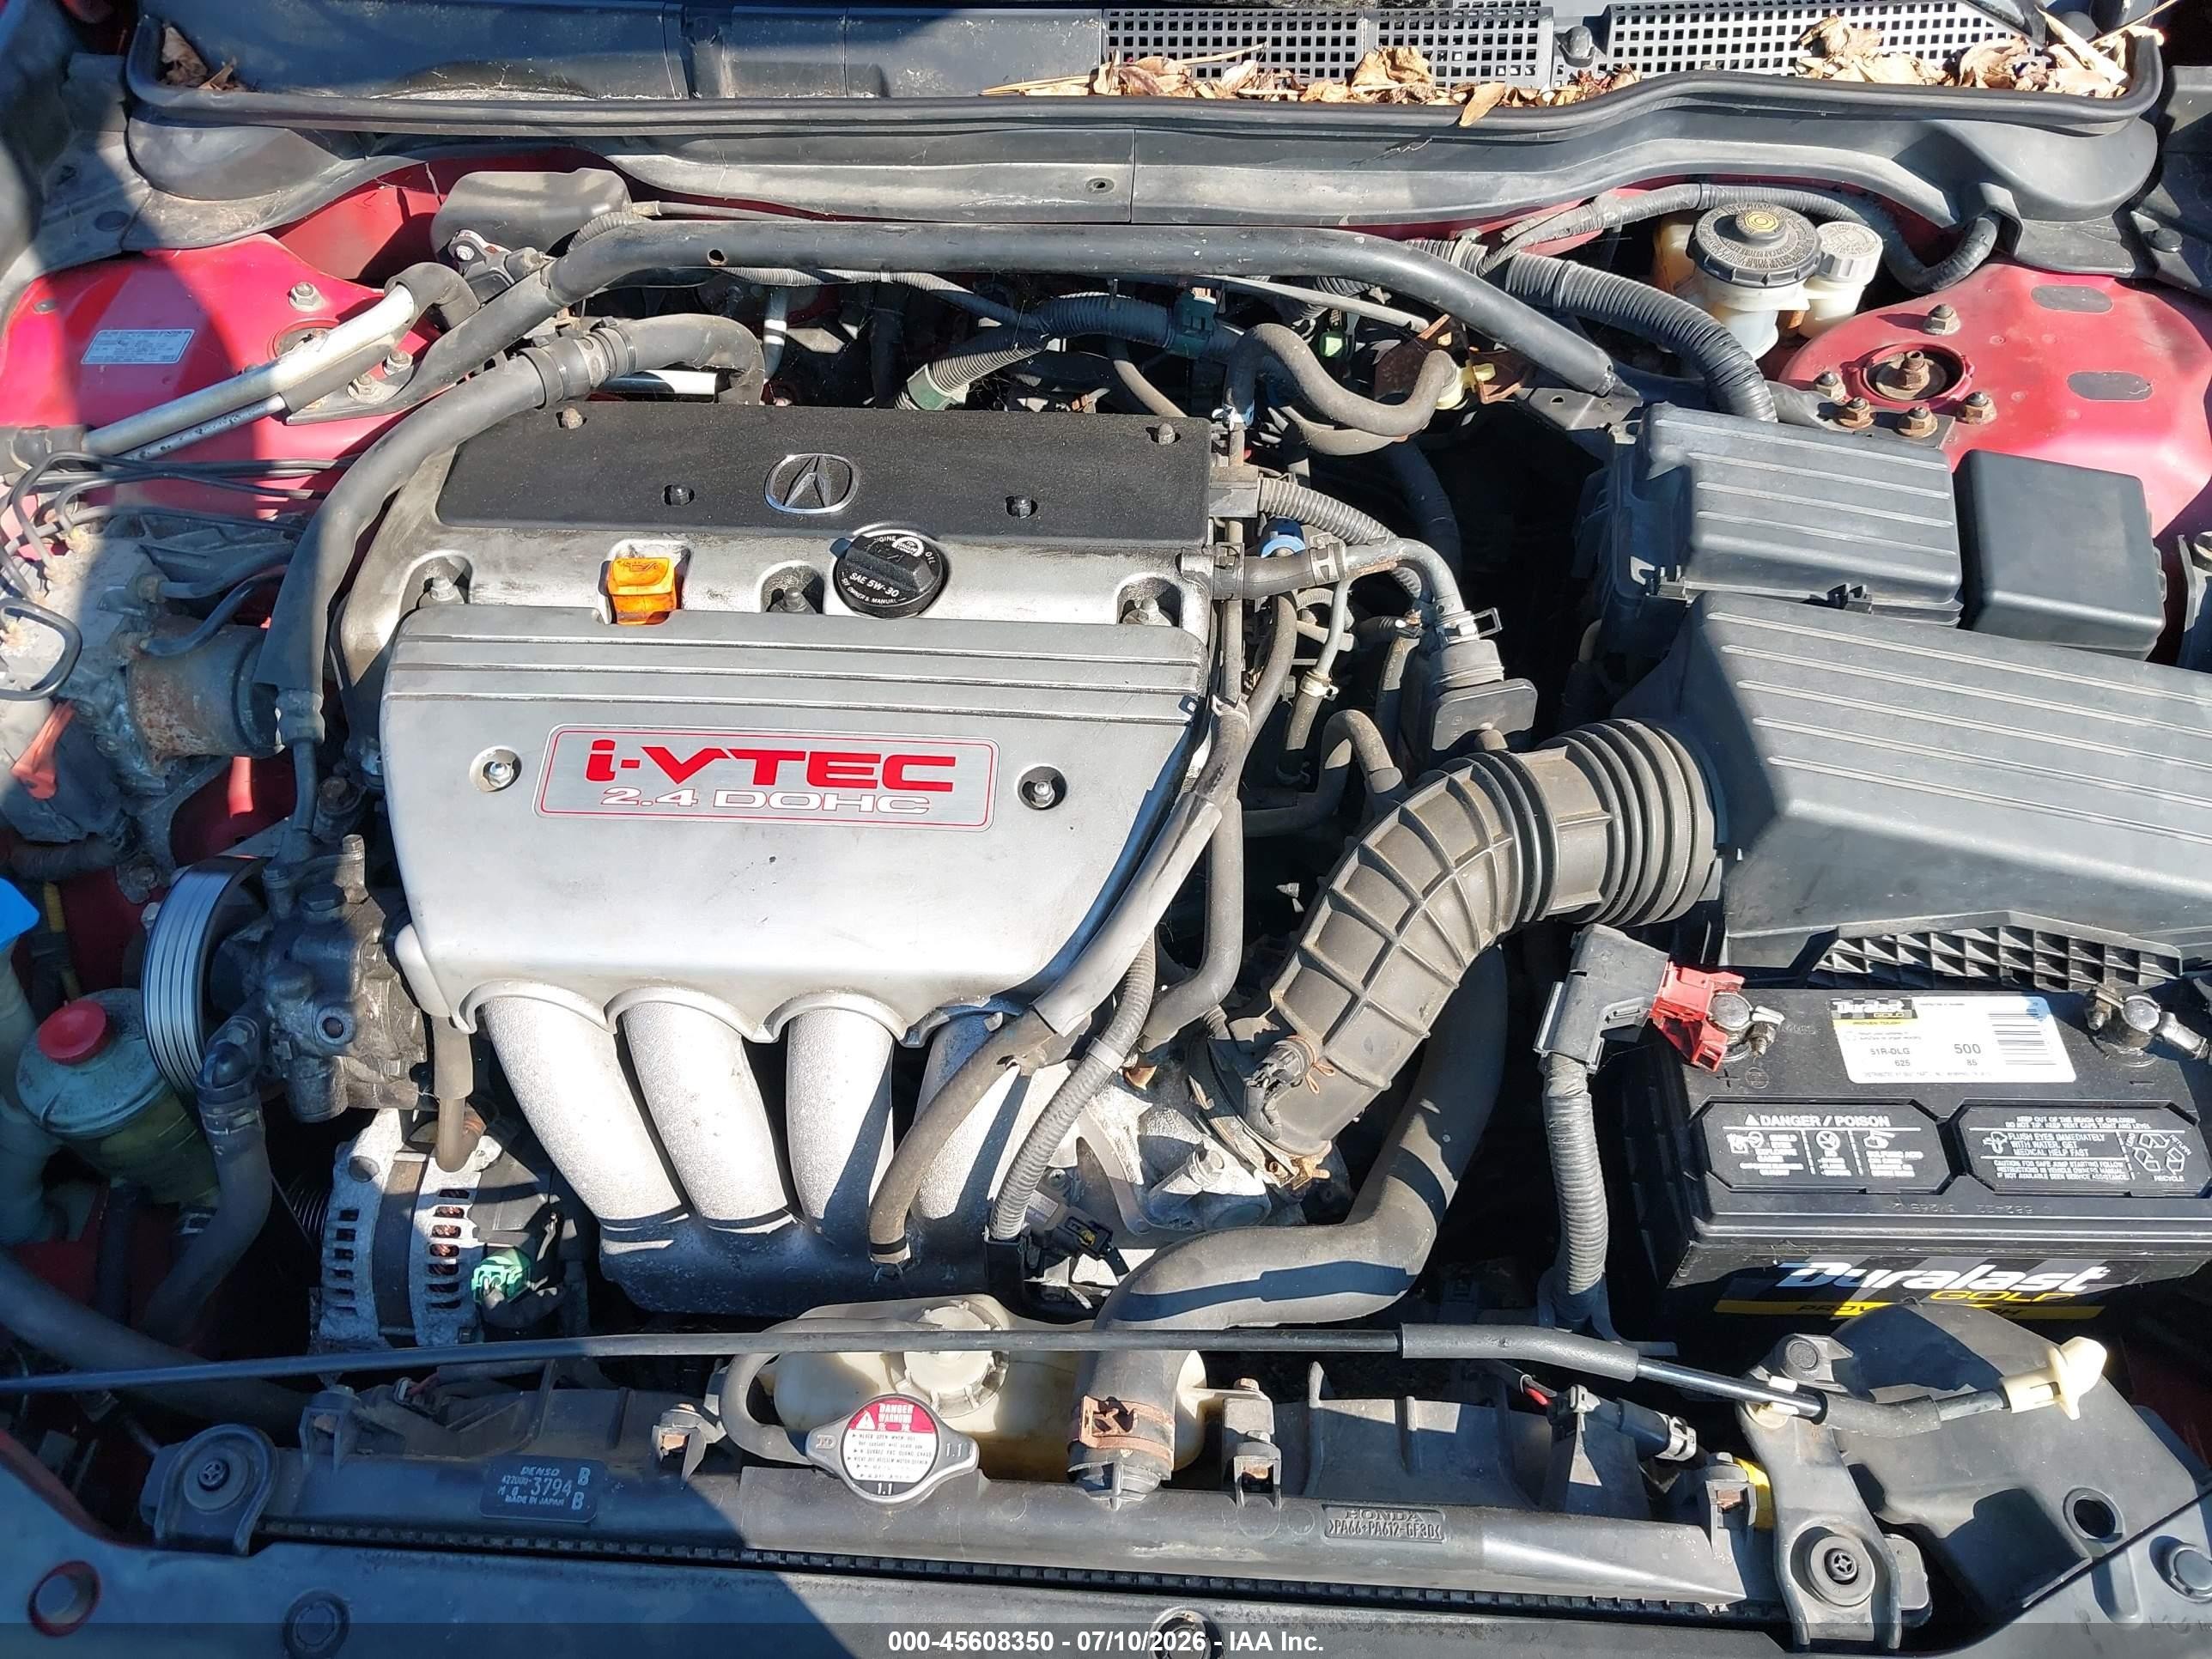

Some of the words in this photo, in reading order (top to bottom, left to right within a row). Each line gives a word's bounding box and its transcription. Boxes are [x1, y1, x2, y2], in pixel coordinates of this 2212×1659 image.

[925, 551, 936, 564] OIL
[849, 572, 867, 585] SAE
[867, 579, 900, 597] 5W-30
[585, 739, 957, 792] i-VTEC
[601, 786, 698, 806] 2.4
[713, 788, 930, 815] DOHC
[1954, 1043, 1982, 1055] 500
[1894, 1059, 1911, 1067] 625
[1759, 1115, 1822, 1127] DANGER
[1835, 1115, 1891, 1127] POISON
[2056, 1133, 2106, 1142] IMMEDIATELY
[2125, 1133, 2136, 1147] LEAD
[2168, 1134, 2192, 1156] RETURN
[1776, 1261, 2111, 1291] Duralast
[1929, 1290, 2075, 1303] GOLD
[878, 1403, 914, 1414] DANGER
[945, 1443, 963, 1457] 1.1
[520, 1466, 561, 1477] DENSO
[577, 1467, 591, 1486] B
[877, 1482, 893, 1495] 1.1
[505, 1495, 527, 1504] MADE
[528, 1497, 538, 1505] IN
[538, 1498, 565, 1506] JAPAN
[572, 1492, 585, 1510] B
[1345, 1509, 1425, 1522] HONDA
